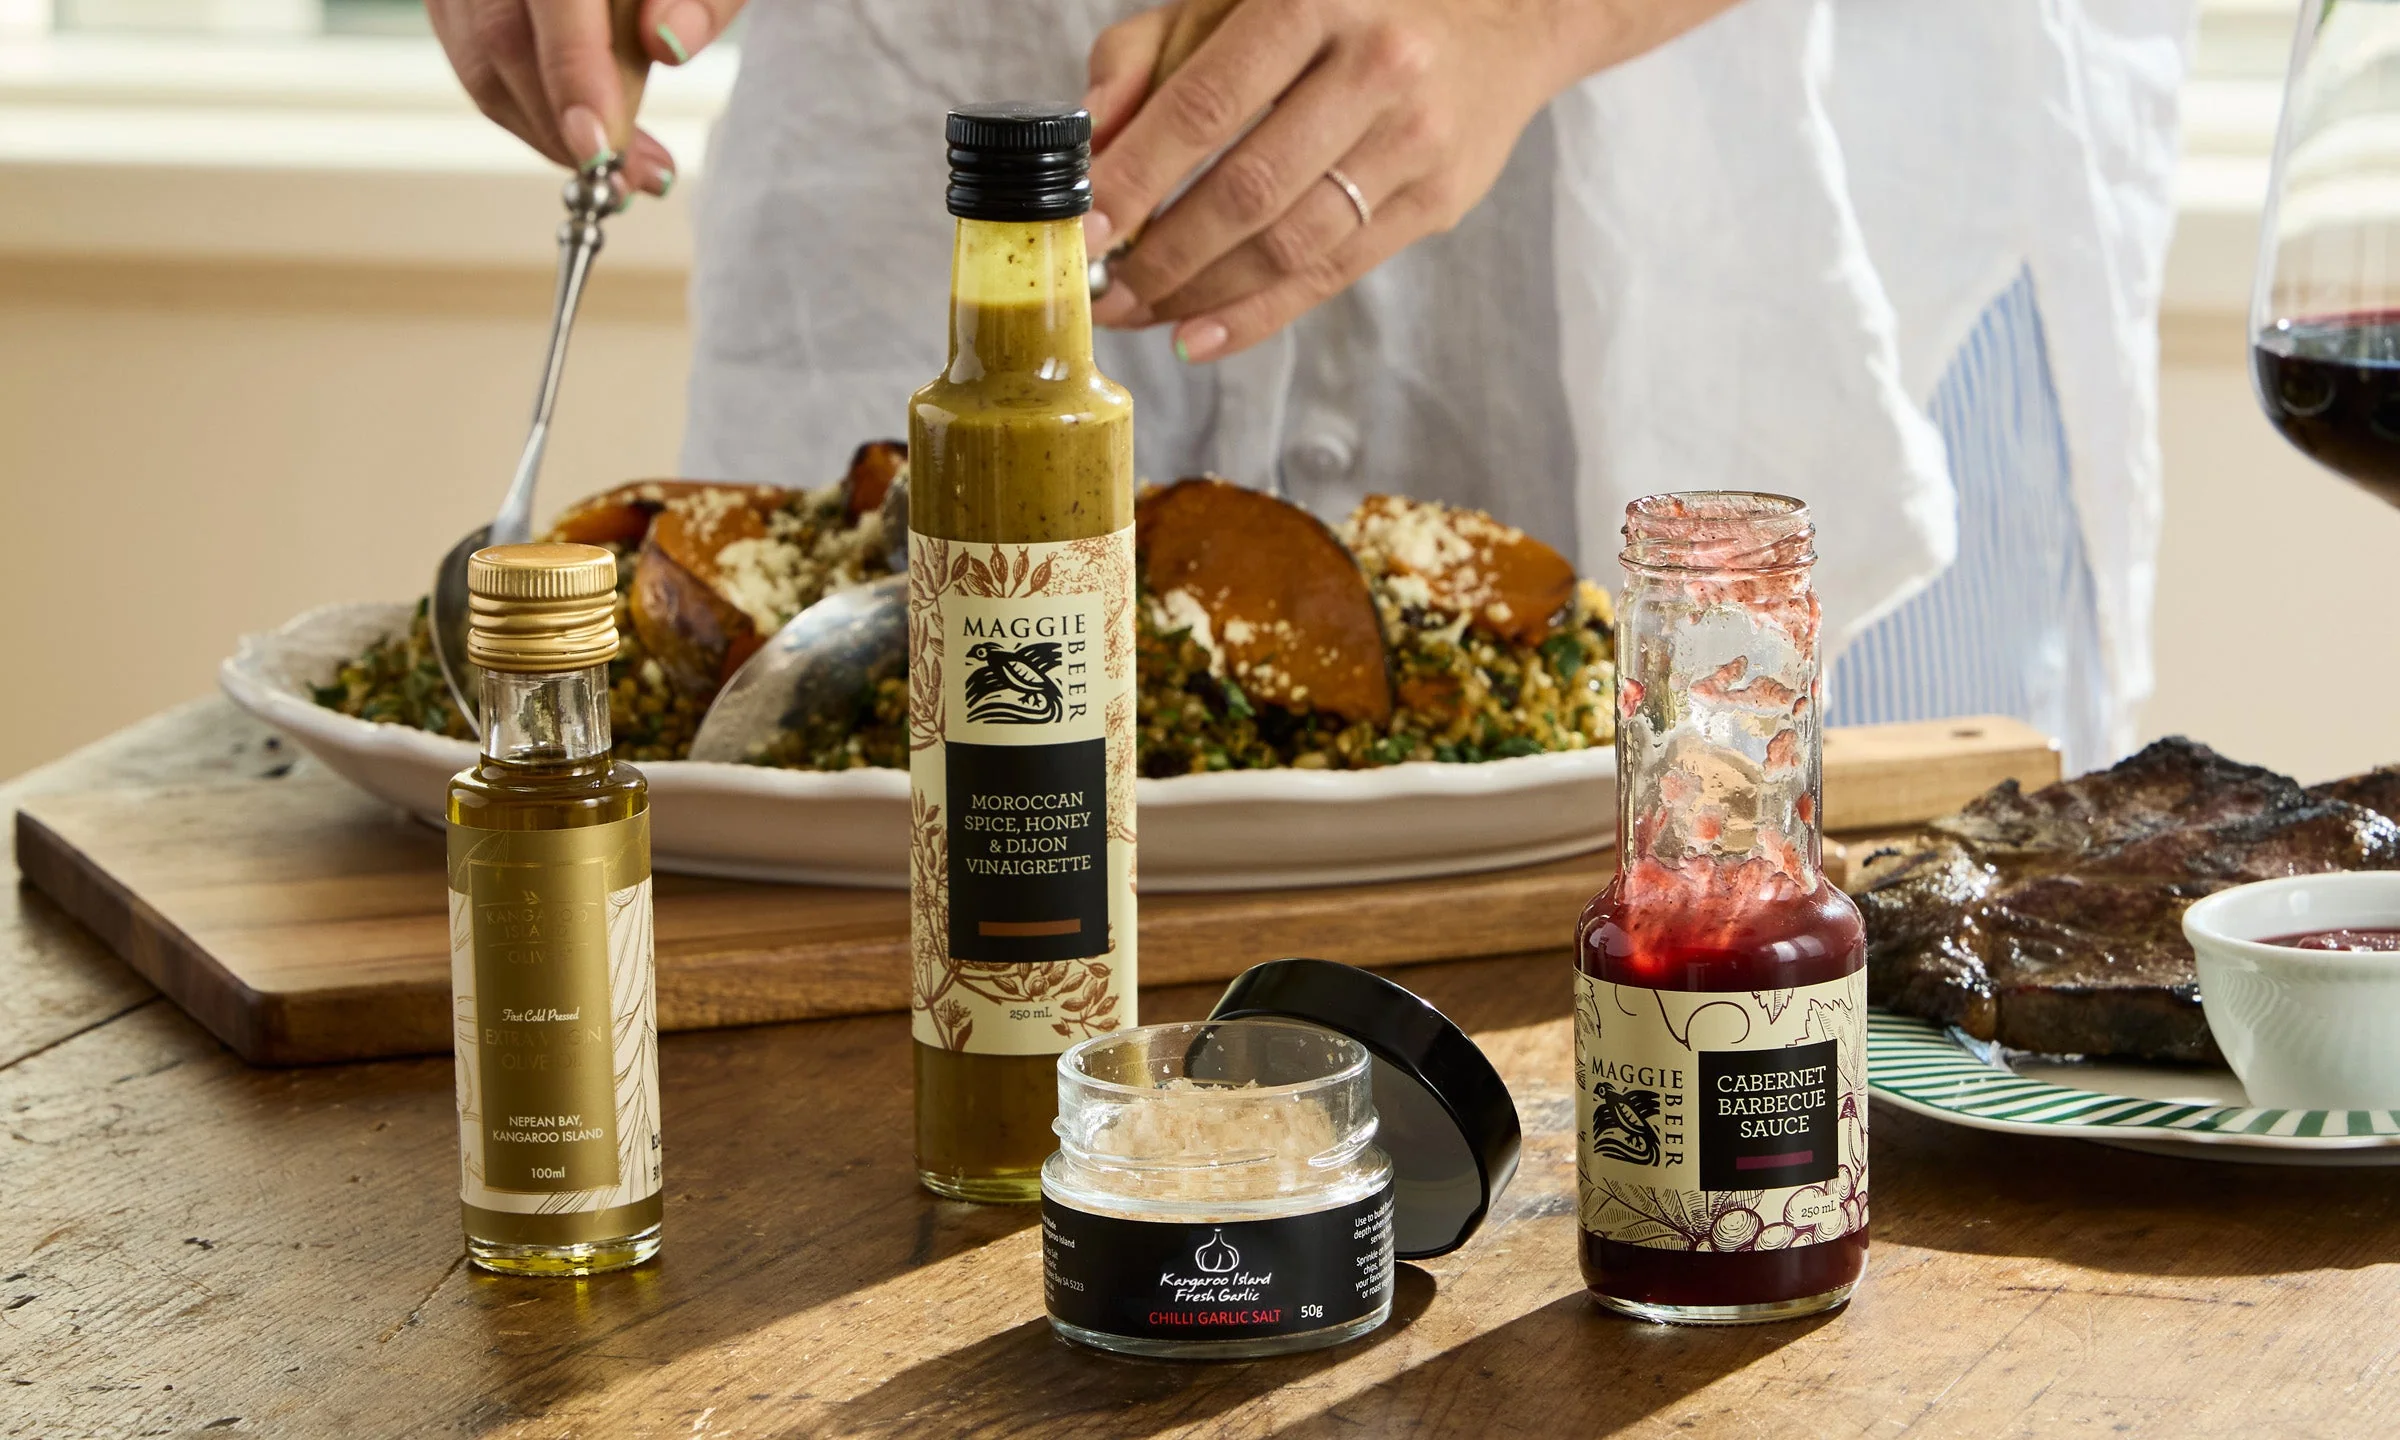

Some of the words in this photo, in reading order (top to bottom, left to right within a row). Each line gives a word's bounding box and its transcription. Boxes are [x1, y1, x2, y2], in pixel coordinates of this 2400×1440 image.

[962, 613, 1086, 639] MAGGIE
[1067, 640, 1087, 722] BEER
[971, 791, 1084, 811] MOROCCAN
[964, 815, 1021, 834] SPICE,
[1025, 811, 1092, 832] HONEY
[989, 839, 1002, 853] &
[1006, 836, 1068, 854] DIJON
[966, 854, 1092, 875] VINAIGRETTE
[502, 1008, 523, 1021] First
[524, 1009, 546, 1022] Cold
[547, 1006, 580, 1021] Pressed
[1009, 1008, 1031, 1020] 250
[1032, 1006, 1053, 1019] mL
[1591, 1056, 1684, 1090] MAGGIE
[1717, 1066, 1826, 1093] CABERNET
[1718, 1089, 1826, 1116] BARBECUE
[509, 1116, 555, 1127] NEPEAN
[558, 1114, 583, 1127] BAY,
[1665, 1093, 1684, 1168] BEER
[1740, 1115, 1810, 1138] SAUCE
[493, 1130, 559, 1143] KANGAROO
[562, 1128, 604, 1142] ISLAND
[531, 1166, 565, 1179] 100ml
[1801, 1205, 1820, 1219] 250
[1821, 1202, 1837, 1216] mL
[1160, 1273, 1229, 1293] Kangaroo
[1232, 1272, 1272, 1286] Island
[1174, 1289, 1215, 1302] Fresh
[1218, 1287, 1260, 1302] Garlic
[1149, 1311, 1193, 1325] CHILLI
[1197, 1310, 1249, 1324] GARLIC
[1252, 1309, 1282, 1323] SALT
[1301, 1303, 1324, 1318] 50g
